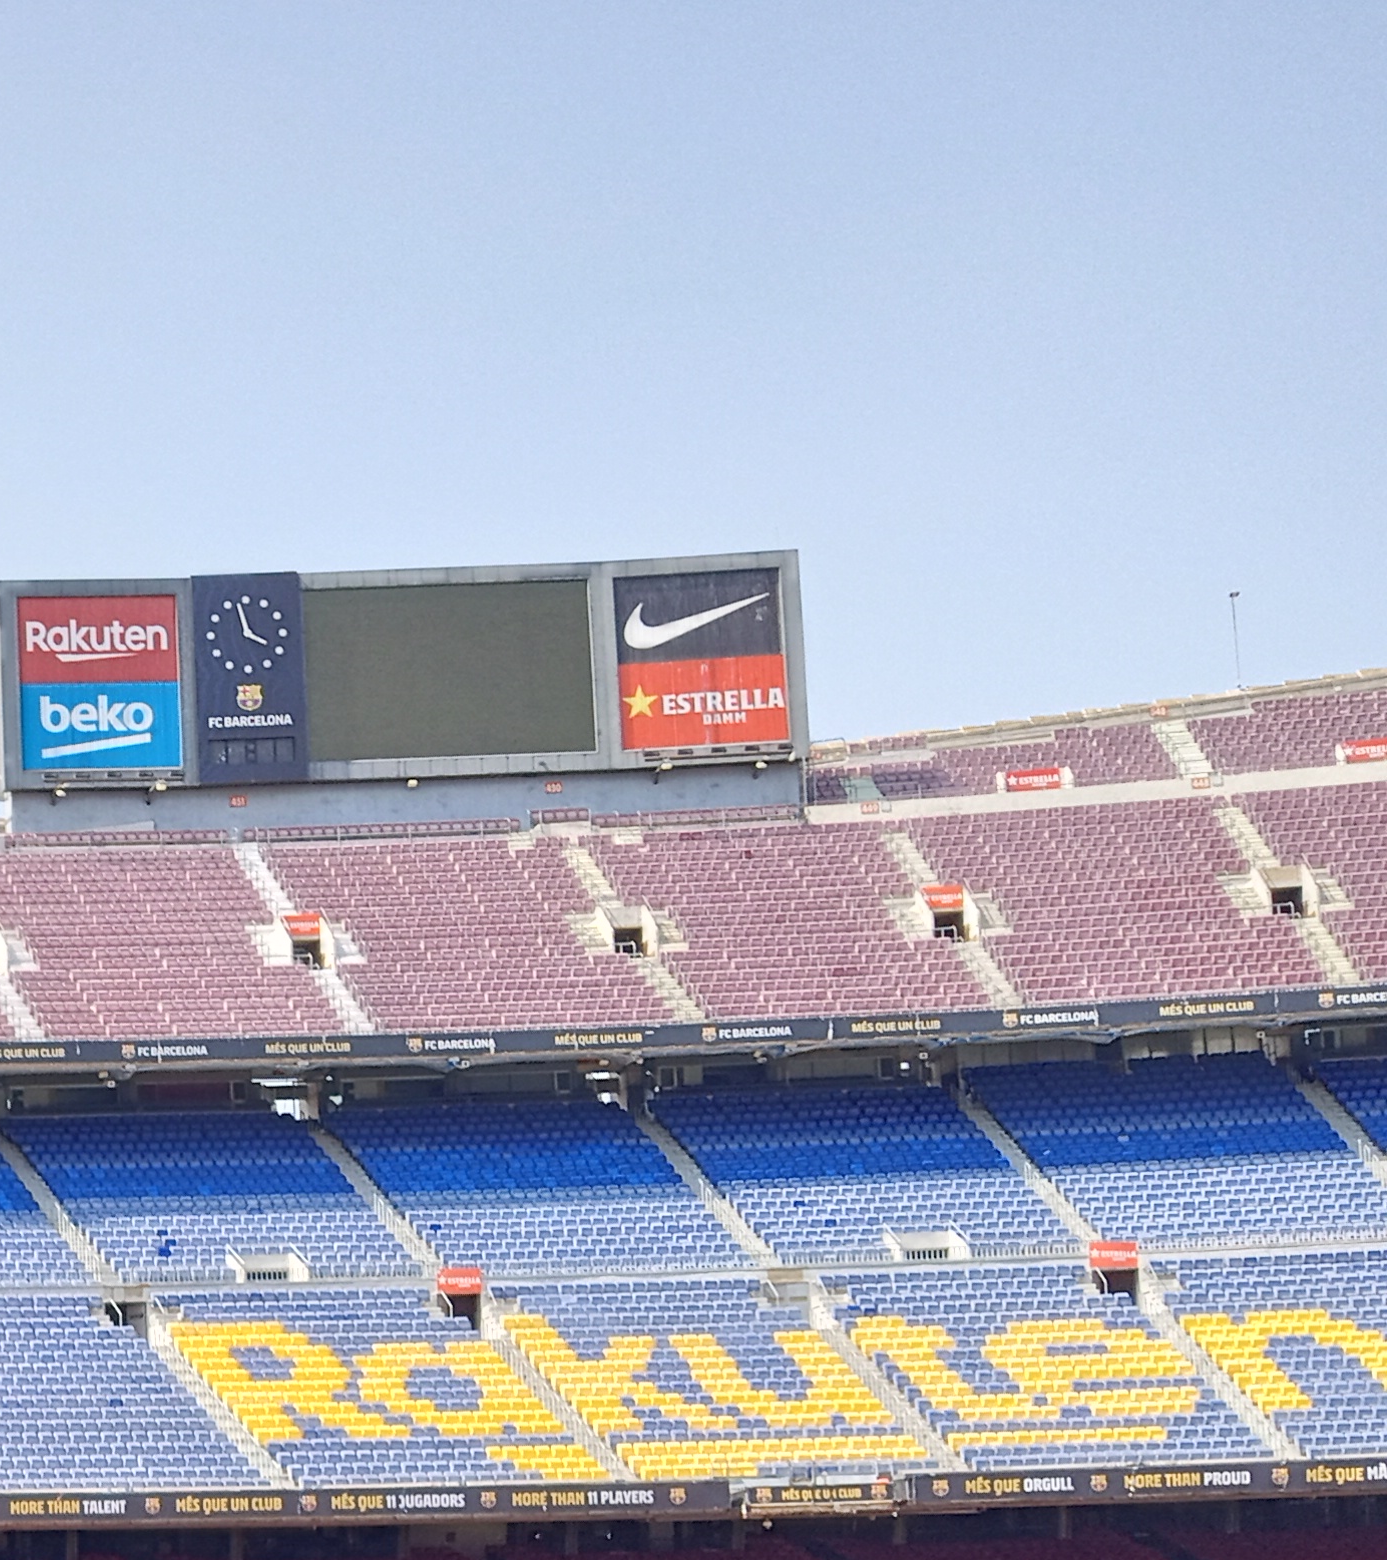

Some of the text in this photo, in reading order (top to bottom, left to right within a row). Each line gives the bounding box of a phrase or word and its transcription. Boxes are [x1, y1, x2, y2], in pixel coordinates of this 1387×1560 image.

[25, 619, 169, 652] Rakuten
[661, 687, 785, 715] ESTRELLA
[39, 694, 154, 733] beko
[208, 714, 294, 728] FC BARCELONA
[702, 712, 746, 725] DAMM
[1336, 992, 1387, 1005] FC BARCE
[1159, 1001, 1254, 1017] MÉS QUE UN CLUB
[1020, 1011, 1095, 1025] FC BARCELONA
[718, 1026, 792, 1039] FC BARCELONA
[851, 1020, 941, 1033] MÉS QUE UN CLUB
[424, 1038, 496, 1051] FC BARCELONA
[554, 1033, 642, 1046] MÉS QUE UN CLUB
[4, 1049, 24, 1060] QUE
[26, 1048, 39, 1058] UN
[40, 1048, 65, 1058] CLUB
[137, 1045, 207, 1057] FC BARCELONA
[265, 1042, 350, 1054] MÉS QUE UN CLUB
[1124, 1471, 1251, 1488] MORE THAN PROUD
[1306, 1465, 1332, 1482] MÉS
[1335, 1468, 1364, 1485] QUE
[965, 1476, 1074, 1496] MÉS QUE ORGULL
[175, 1495, 283, 1516] MÉS QUE UN CLUB
[331, 1493, 466, 1512] MÉS QUE 11 JUGADORS
[512, 1490, 654, 1507] MORE THAN 11 PLAYERS
[10, 1499, 126, 1515] MORE THAN TALENT
